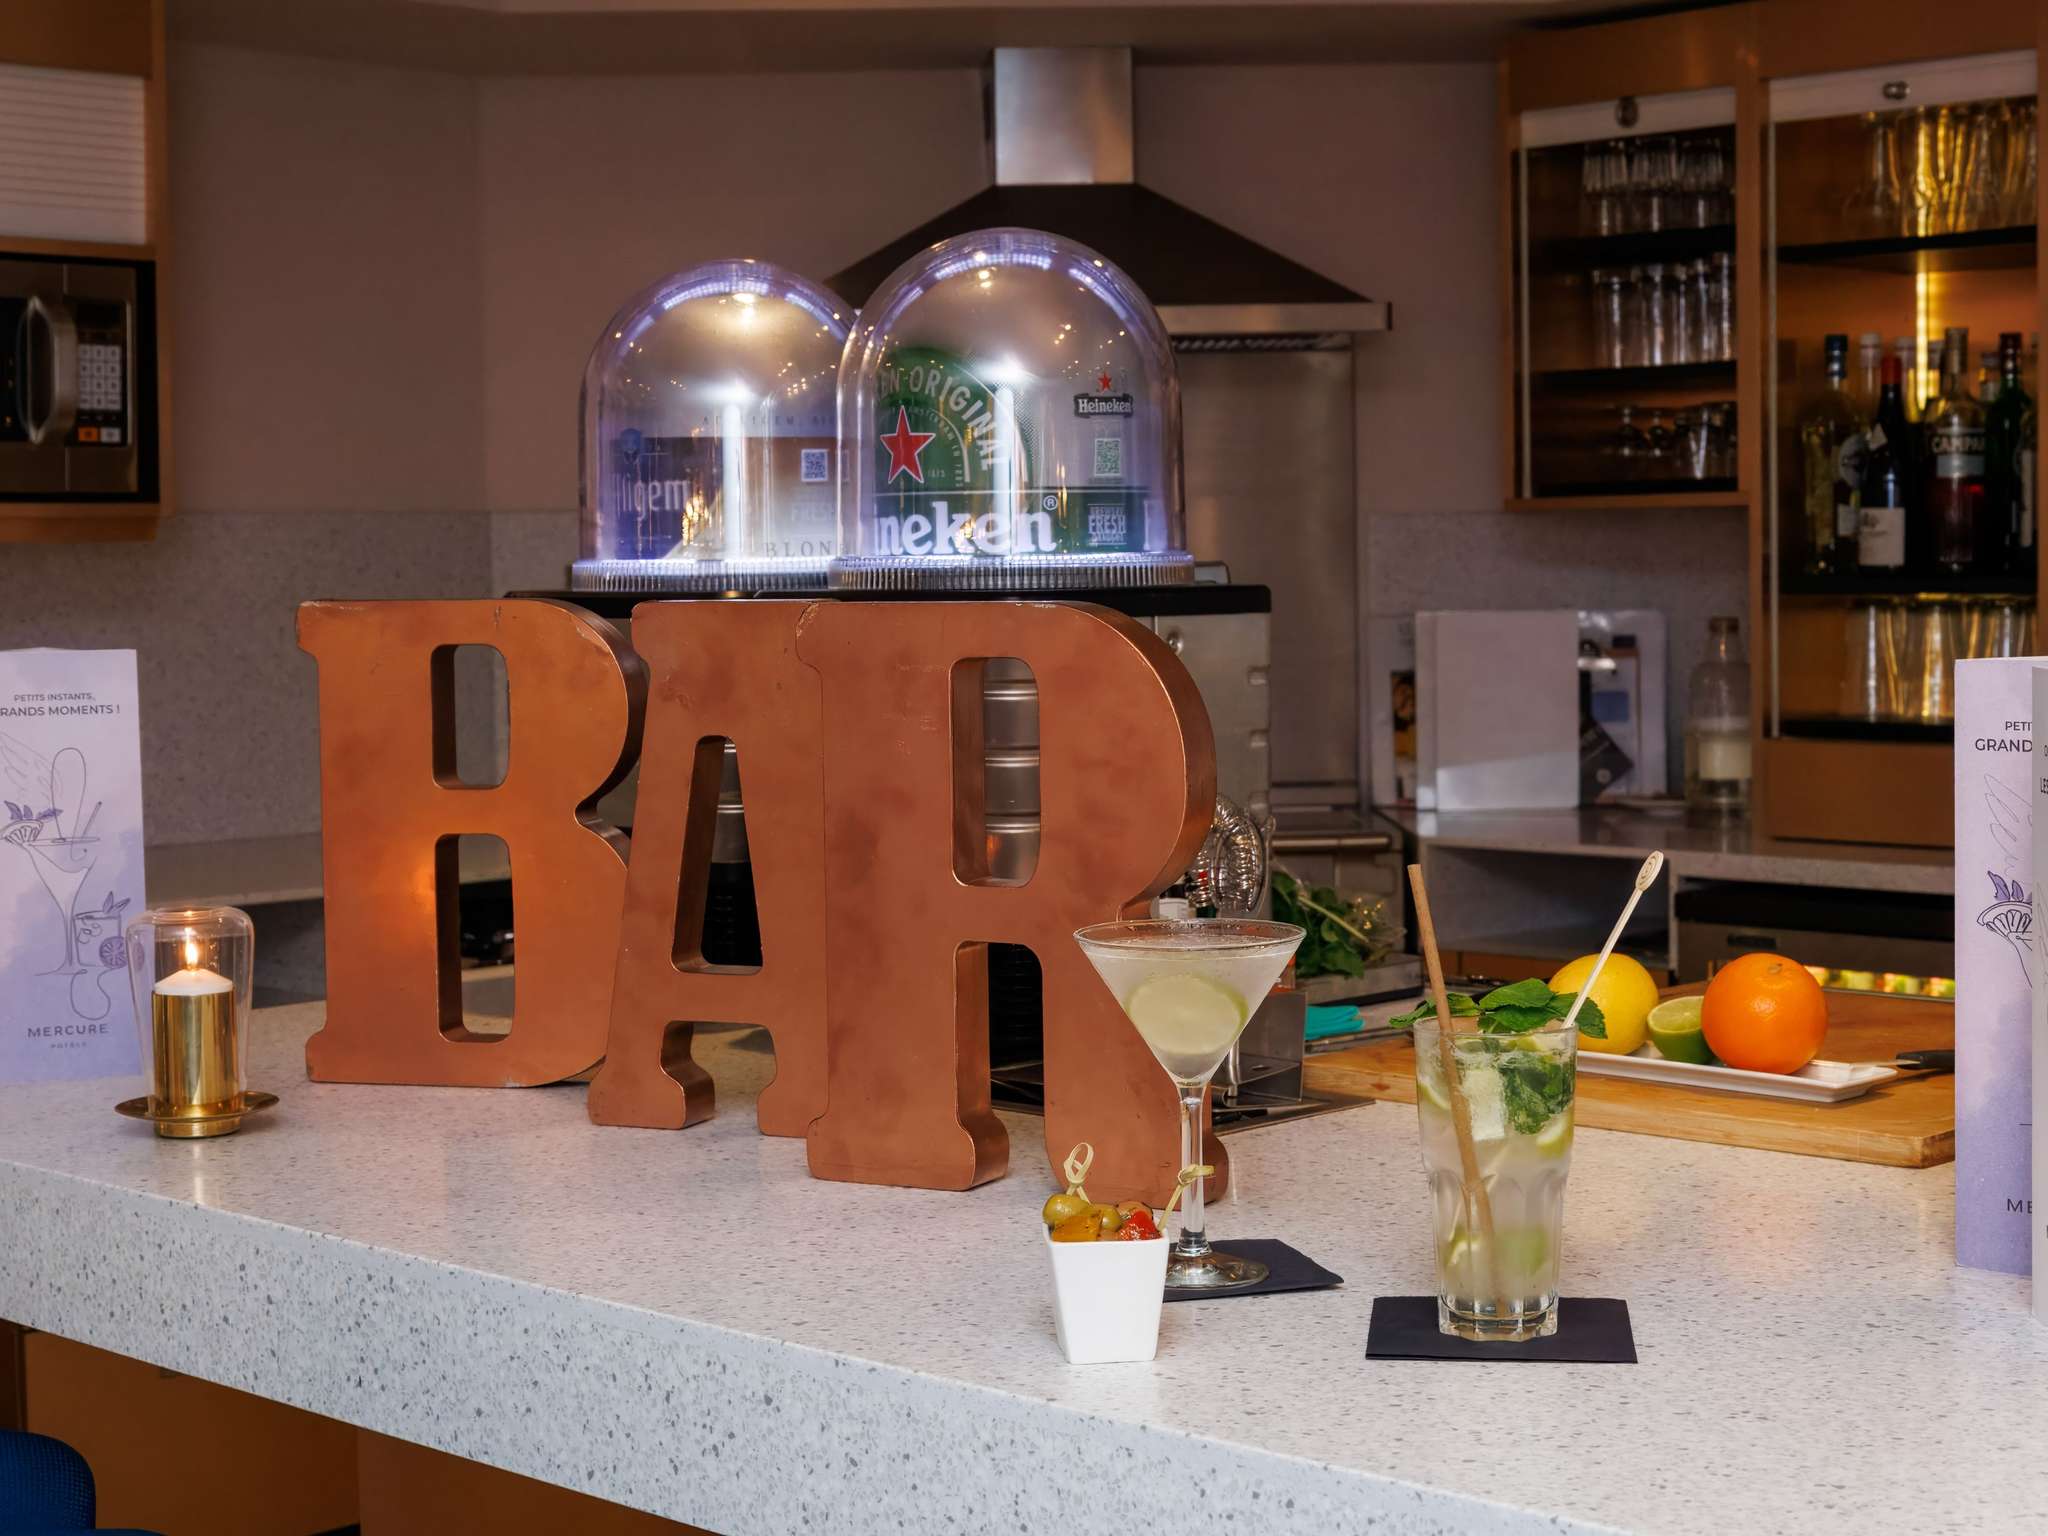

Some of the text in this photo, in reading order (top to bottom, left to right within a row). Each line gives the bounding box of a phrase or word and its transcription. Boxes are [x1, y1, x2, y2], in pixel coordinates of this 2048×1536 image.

[1077, 398, 1132, 413] Heineken
[1087, 515, 1127, 534] FRESH
[13, 692, 97, 702] PETITS INSTANTS,
[48, 704, 114, 716] MOMENTS
[116, 703, 121, 714] !
[1974, 738, 2032, 753] GRAND
[296, 599, 1230, 1212] BAR
[27, 1023, 110, 1038] MERCURE
